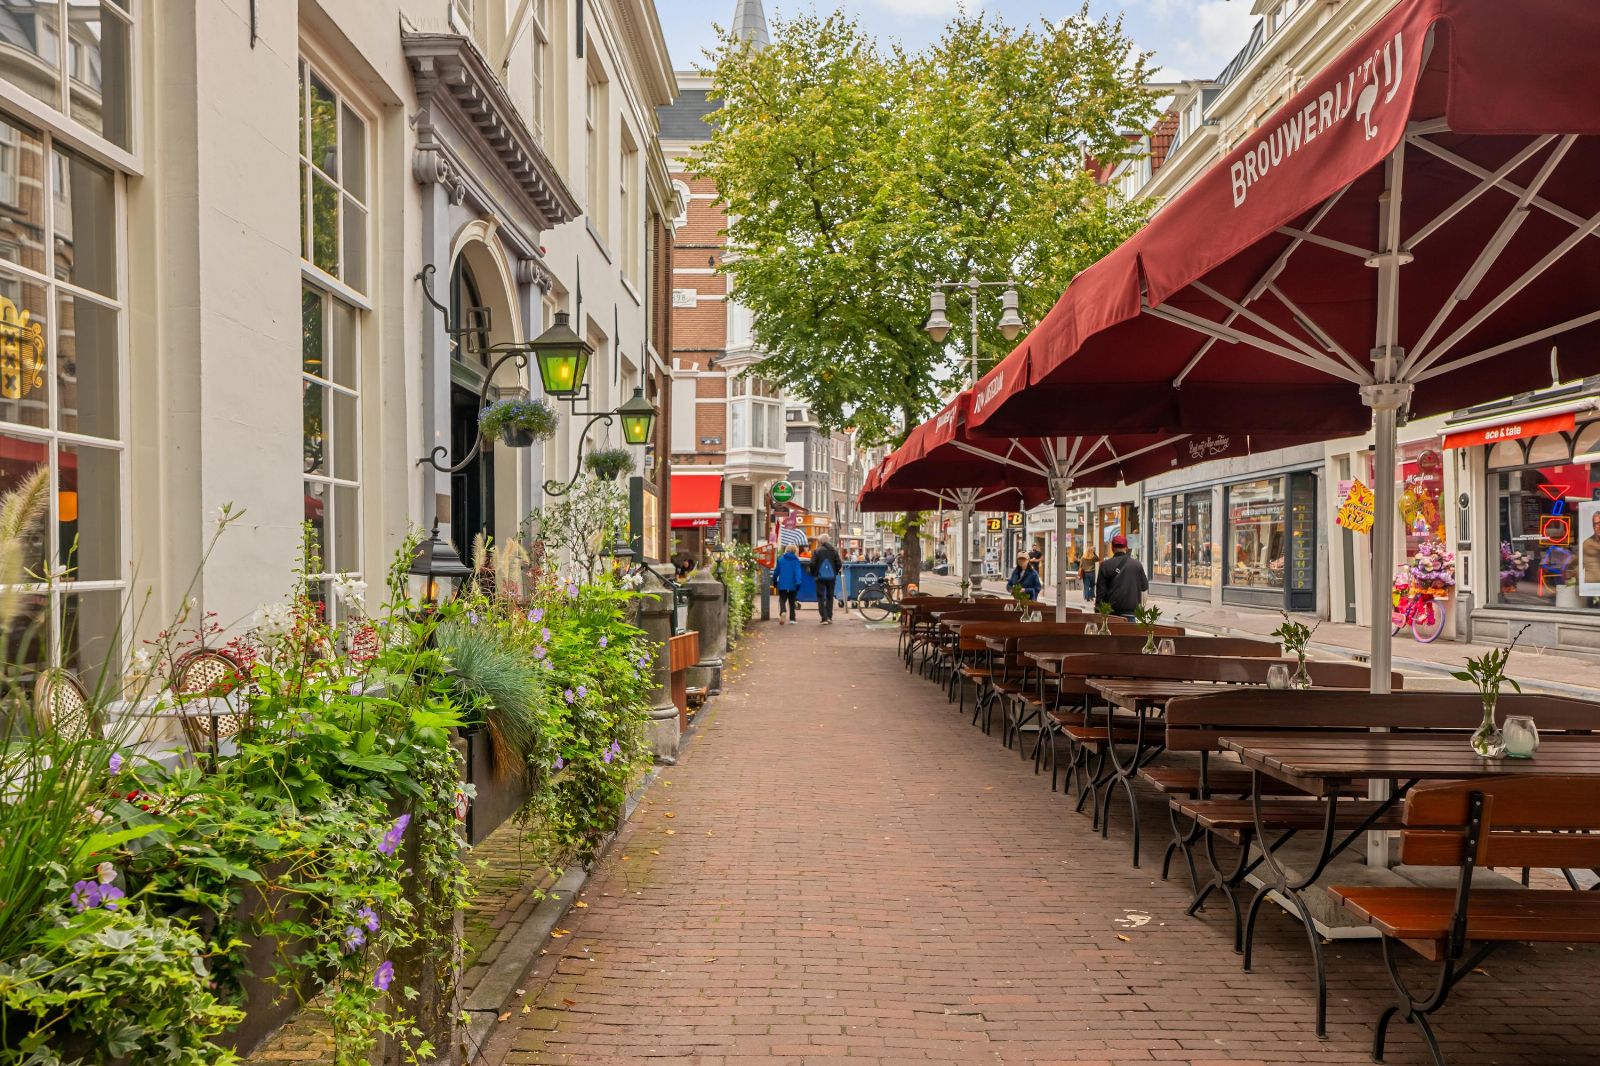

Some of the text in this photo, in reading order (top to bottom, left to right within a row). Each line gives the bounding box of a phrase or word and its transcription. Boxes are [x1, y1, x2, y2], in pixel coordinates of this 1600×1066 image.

[1231, 71, 1355, 208] BROUWERIJ
[1485, 425, 1522, 440] ace & tate
